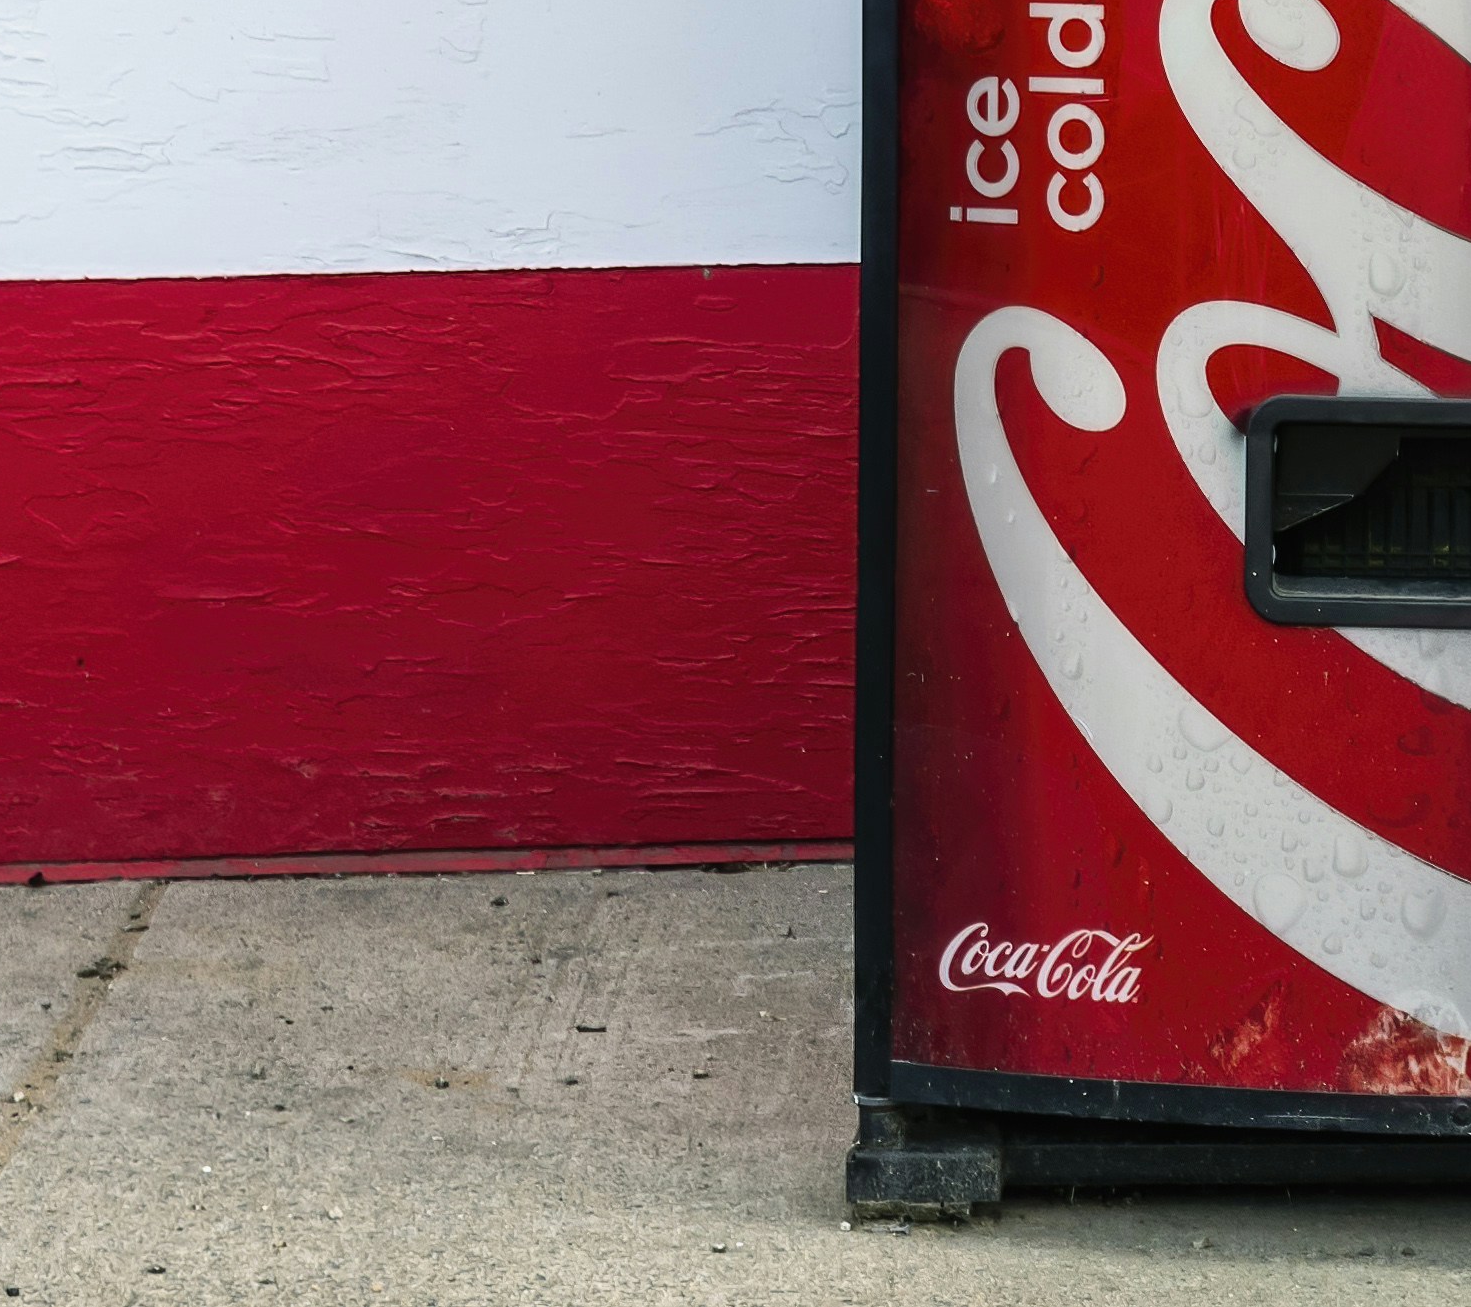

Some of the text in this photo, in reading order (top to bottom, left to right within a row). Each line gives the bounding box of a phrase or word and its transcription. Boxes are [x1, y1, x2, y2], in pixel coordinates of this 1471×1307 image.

[949, 76, 1021, 225] ice
[1029, 1, 1106, 233] cold
[939, 922, 1155, 1004] Coca-Cola
